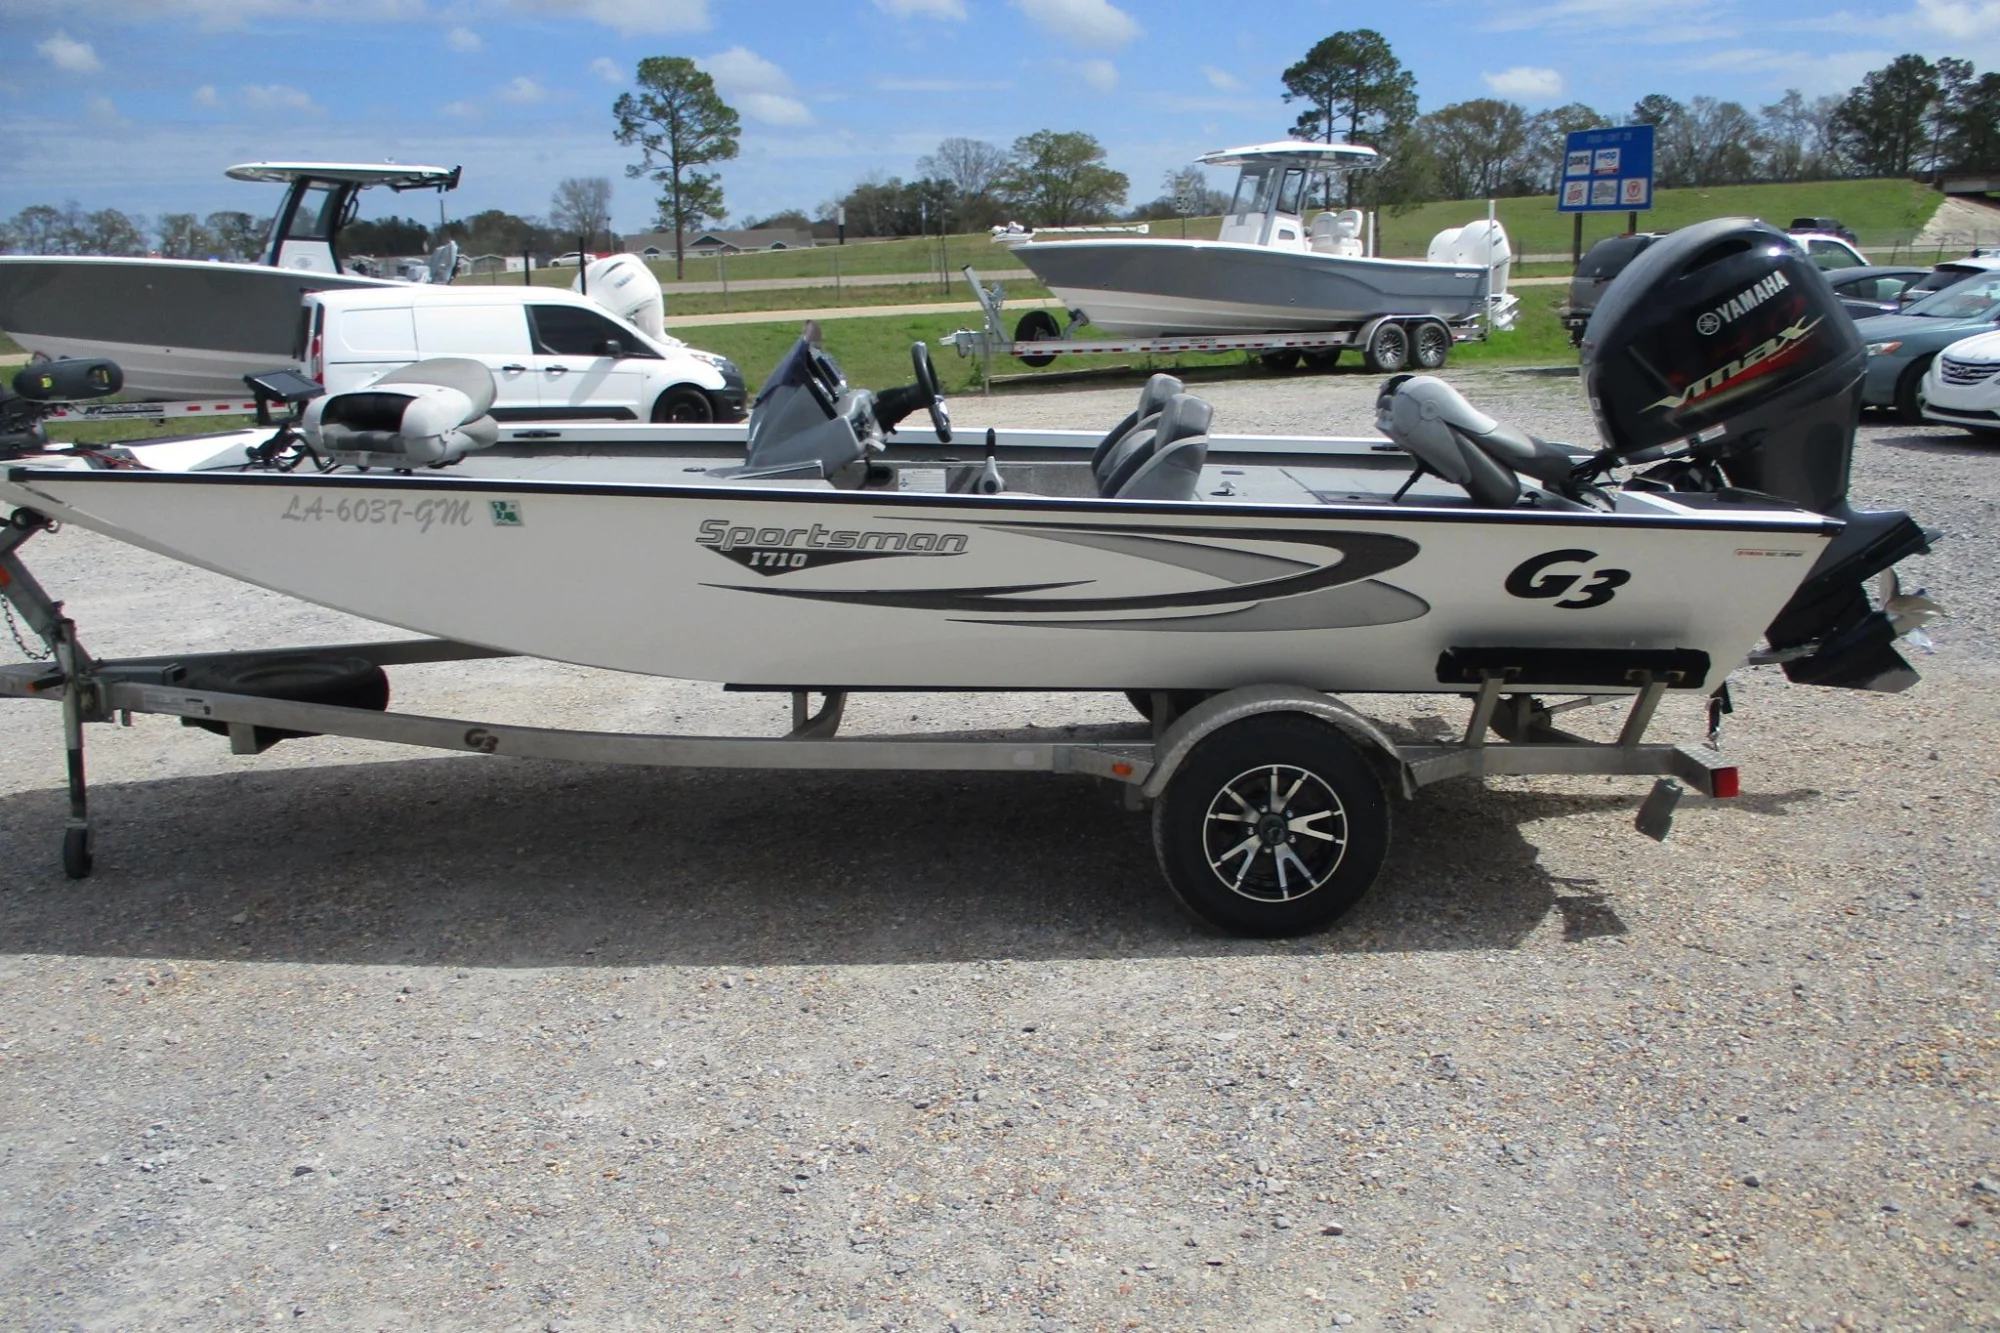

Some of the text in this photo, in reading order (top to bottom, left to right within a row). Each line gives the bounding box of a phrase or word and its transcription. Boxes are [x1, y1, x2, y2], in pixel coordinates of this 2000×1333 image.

[1716, 270, 1790, 323] YAMAHA
[695, 519, 969, 551] Sportsman
[748, 551, 806, 567] 1710
[1504, 549, 1631, 609] G3
[464, 728, 499, 754] G3
